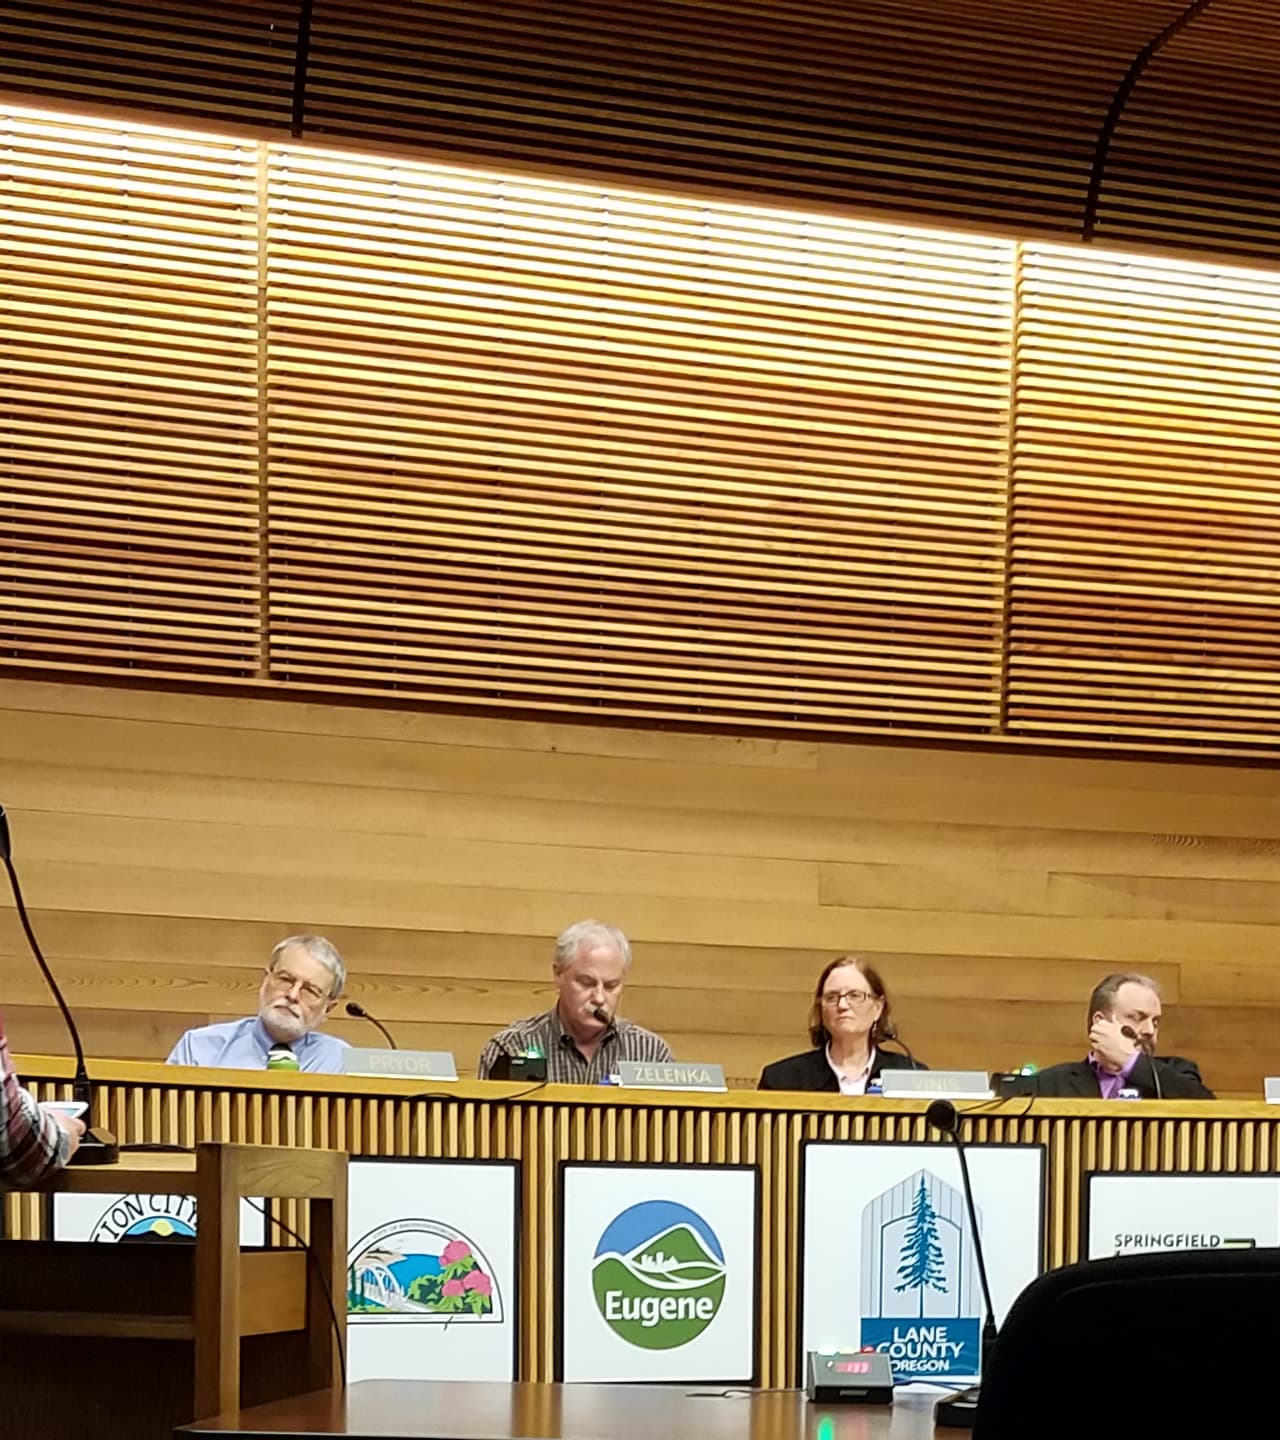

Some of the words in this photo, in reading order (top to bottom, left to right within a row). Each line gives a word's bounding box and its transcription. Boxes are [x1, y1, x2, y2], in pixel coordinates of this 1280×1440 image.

[369, 1055, 432, 1073] PRYOR
[634, 1067, 713, 1083] ZELENKA
[1114, 1233, 1220, 1248] SPRINGFIELD
[606, 1290, 714, 1327] Eugene
[893, 1327, 948, 1343] LANE
[876, 1342, 965, 1359] COUNTY
